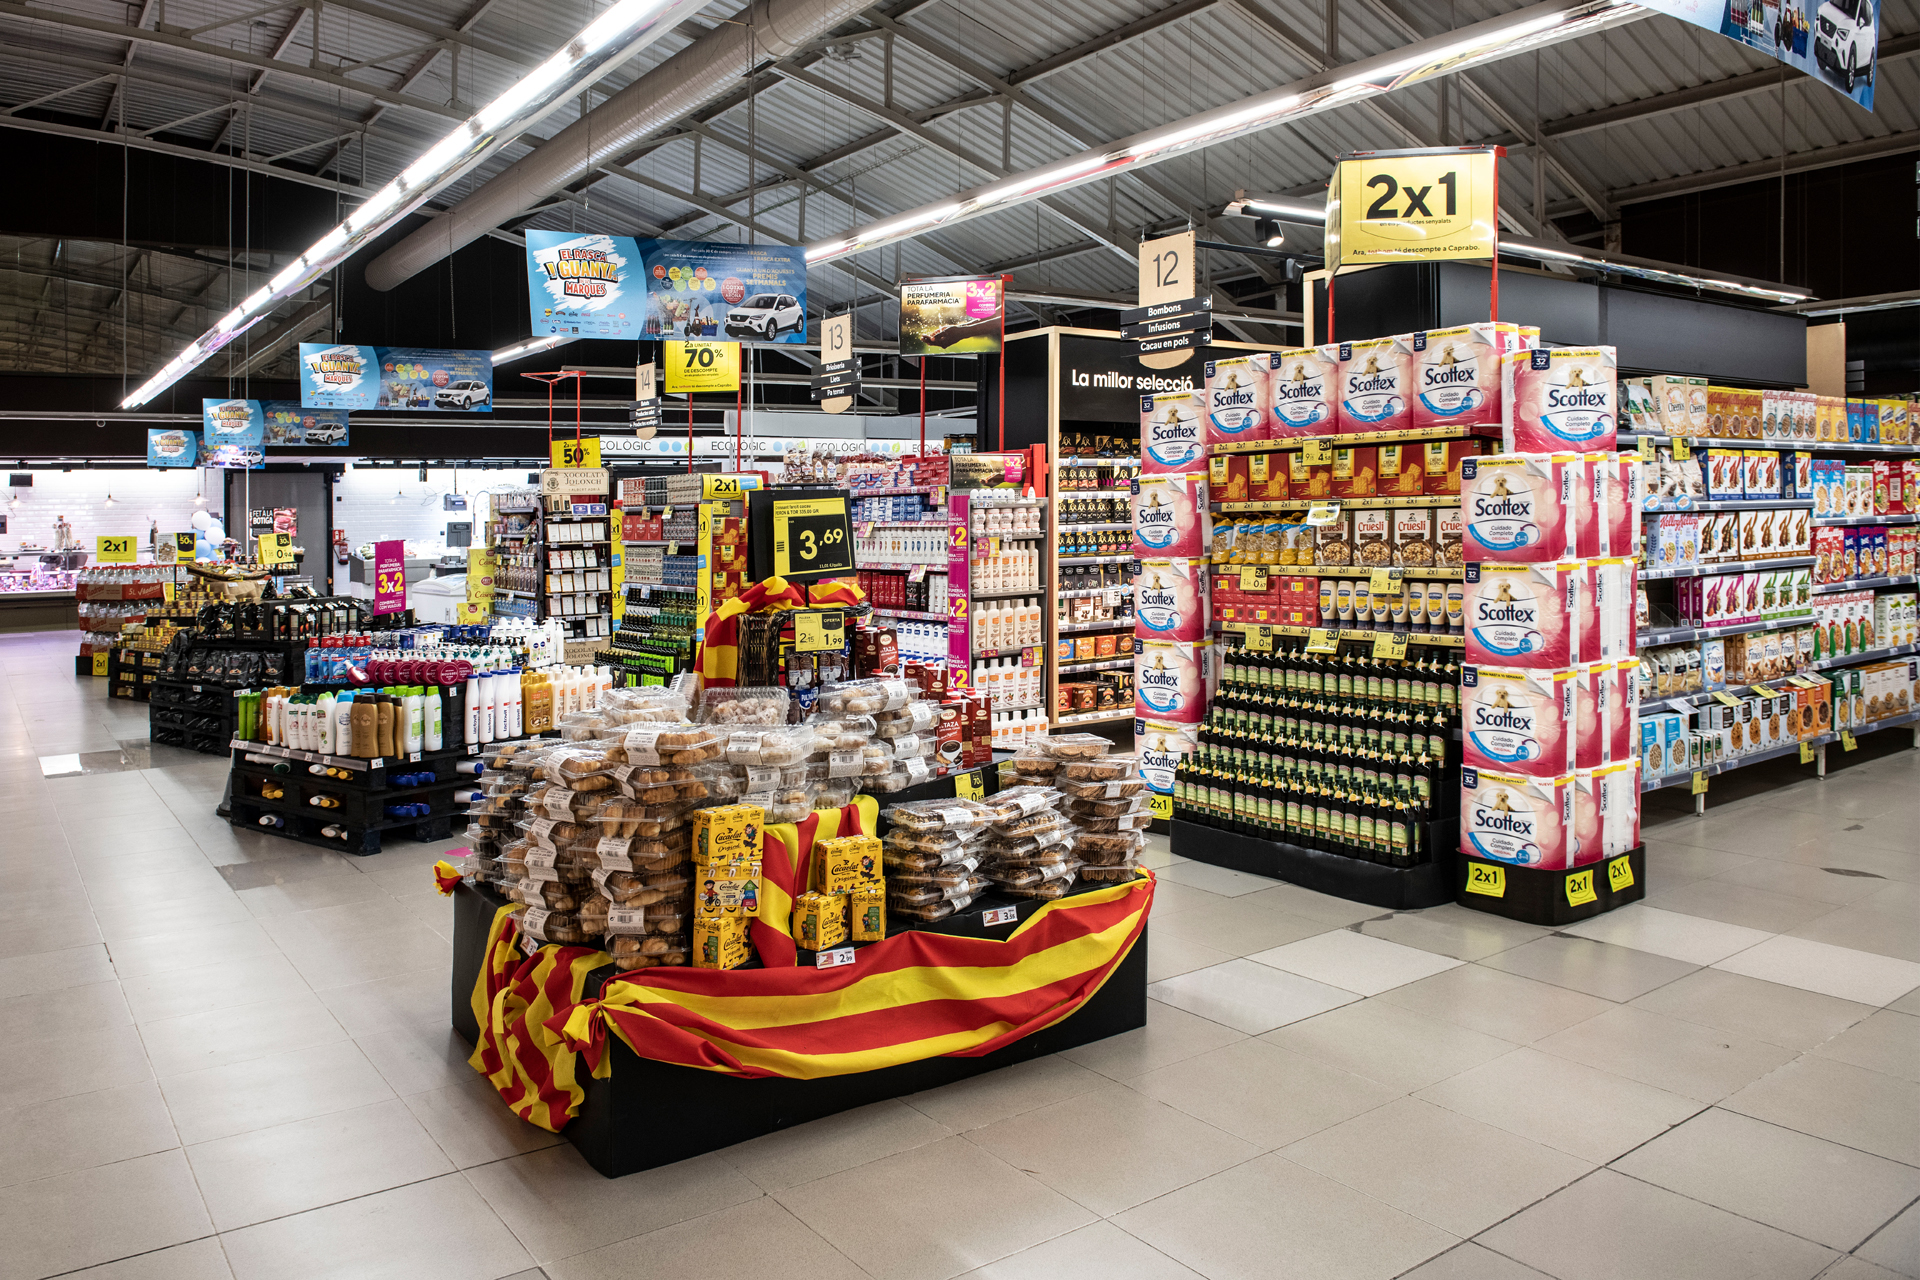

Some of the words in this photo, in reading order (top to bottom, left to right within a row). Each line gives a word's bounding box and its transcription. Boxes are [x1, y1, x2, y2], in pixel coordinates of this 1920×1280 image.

[1366, 171, 1457, 220] 2x1
[1425, 218, 1452, 226] senyalats
[561, 250, 572, 260] EL
[574, 249, 607, 262] RASCA
[1403, 246, 1442, 254] descompte
[1448, 244, 1480, 252] Caprabo.
[558, 259, 618, 281] GUANYA
[1152, 250, 1178, 288] 12
[565, 282, 607, 297] MARQUES
[966, 282, 996, 297] 3x2
[1148, 304, 1182, 316] Bombons
[1148, 320, 1180, 332] Infusions
[828, 324, 844, 350] 13
[1140, 339, 1162, 351] Cacau
[1164, 339, 1172, 348] en
[1173, 336, 1189, 348] pols
[1536, 358, 1546, 366] 32
[640, 370, 650, 390] 14
[1072, 369, 1090, 387] La
[1093, 371, 1134, 388] millor
[1136, 374, 1194, 391] selecció
[1424, 366, 1475, 386] Scottex
[1280, 382, 1322, 400] Scottex
[1349, 375, 1396, 394] Scottex
[1214, 390, 1254, 408] Scottex
[1548, 388, 1608, 408] Scottex
[1152, 424, 1197, 440] Scottex
[600, 440, 652, 451] COLÒGIC
[1004, 457, 1021, 468] 3x2
[1464, 467, 1474, 475] 32
[714, 478, 737, 492] 2x1
[1474, 497, 1531, 517] Scottex
[1139, 508, 1174, 524] Scottex
[1358, 522, 1384, 532] Cruesli
[1398, 520, 1426, 531] Cruesli
[103, 540, 128, 552] 2x1
[800, 528, 844, 560] 3,69
[378, 572, 404, 594] 3x2
[1141, 590, 1176, 607] Scottex
[1478, 602, 1535, 622] Scottex
[824, 633, 842, 646] 1,99
[1142, 670, 1178, 686] Scottex
[1465, 674, 1474, 683] 32
[1476, 706, 1532, 730] Scottex
[1490, 740, 1516, 748] Completo
[1492, 735, 1514, 743] Cuidado
[1465, 776, 1474, 784] 32
[1150, 798, 1167, 810] 2x1
[1475, 809, 1532, 835] Scottex
[716, 831, 742, 844] Cacaolat
[1492, 838, 1514, 846] Cuidado
[1490, 843, 1516, 852] Completo
[832, 862, 859, 876] Cacaolat
[1474, 868, 1498, 884] 2x1
[1611, 862, 1626, 879] 2x1
[720, 883, 740, 891] Cacaolat
[1570, 876, 1588, 893] 2x1
